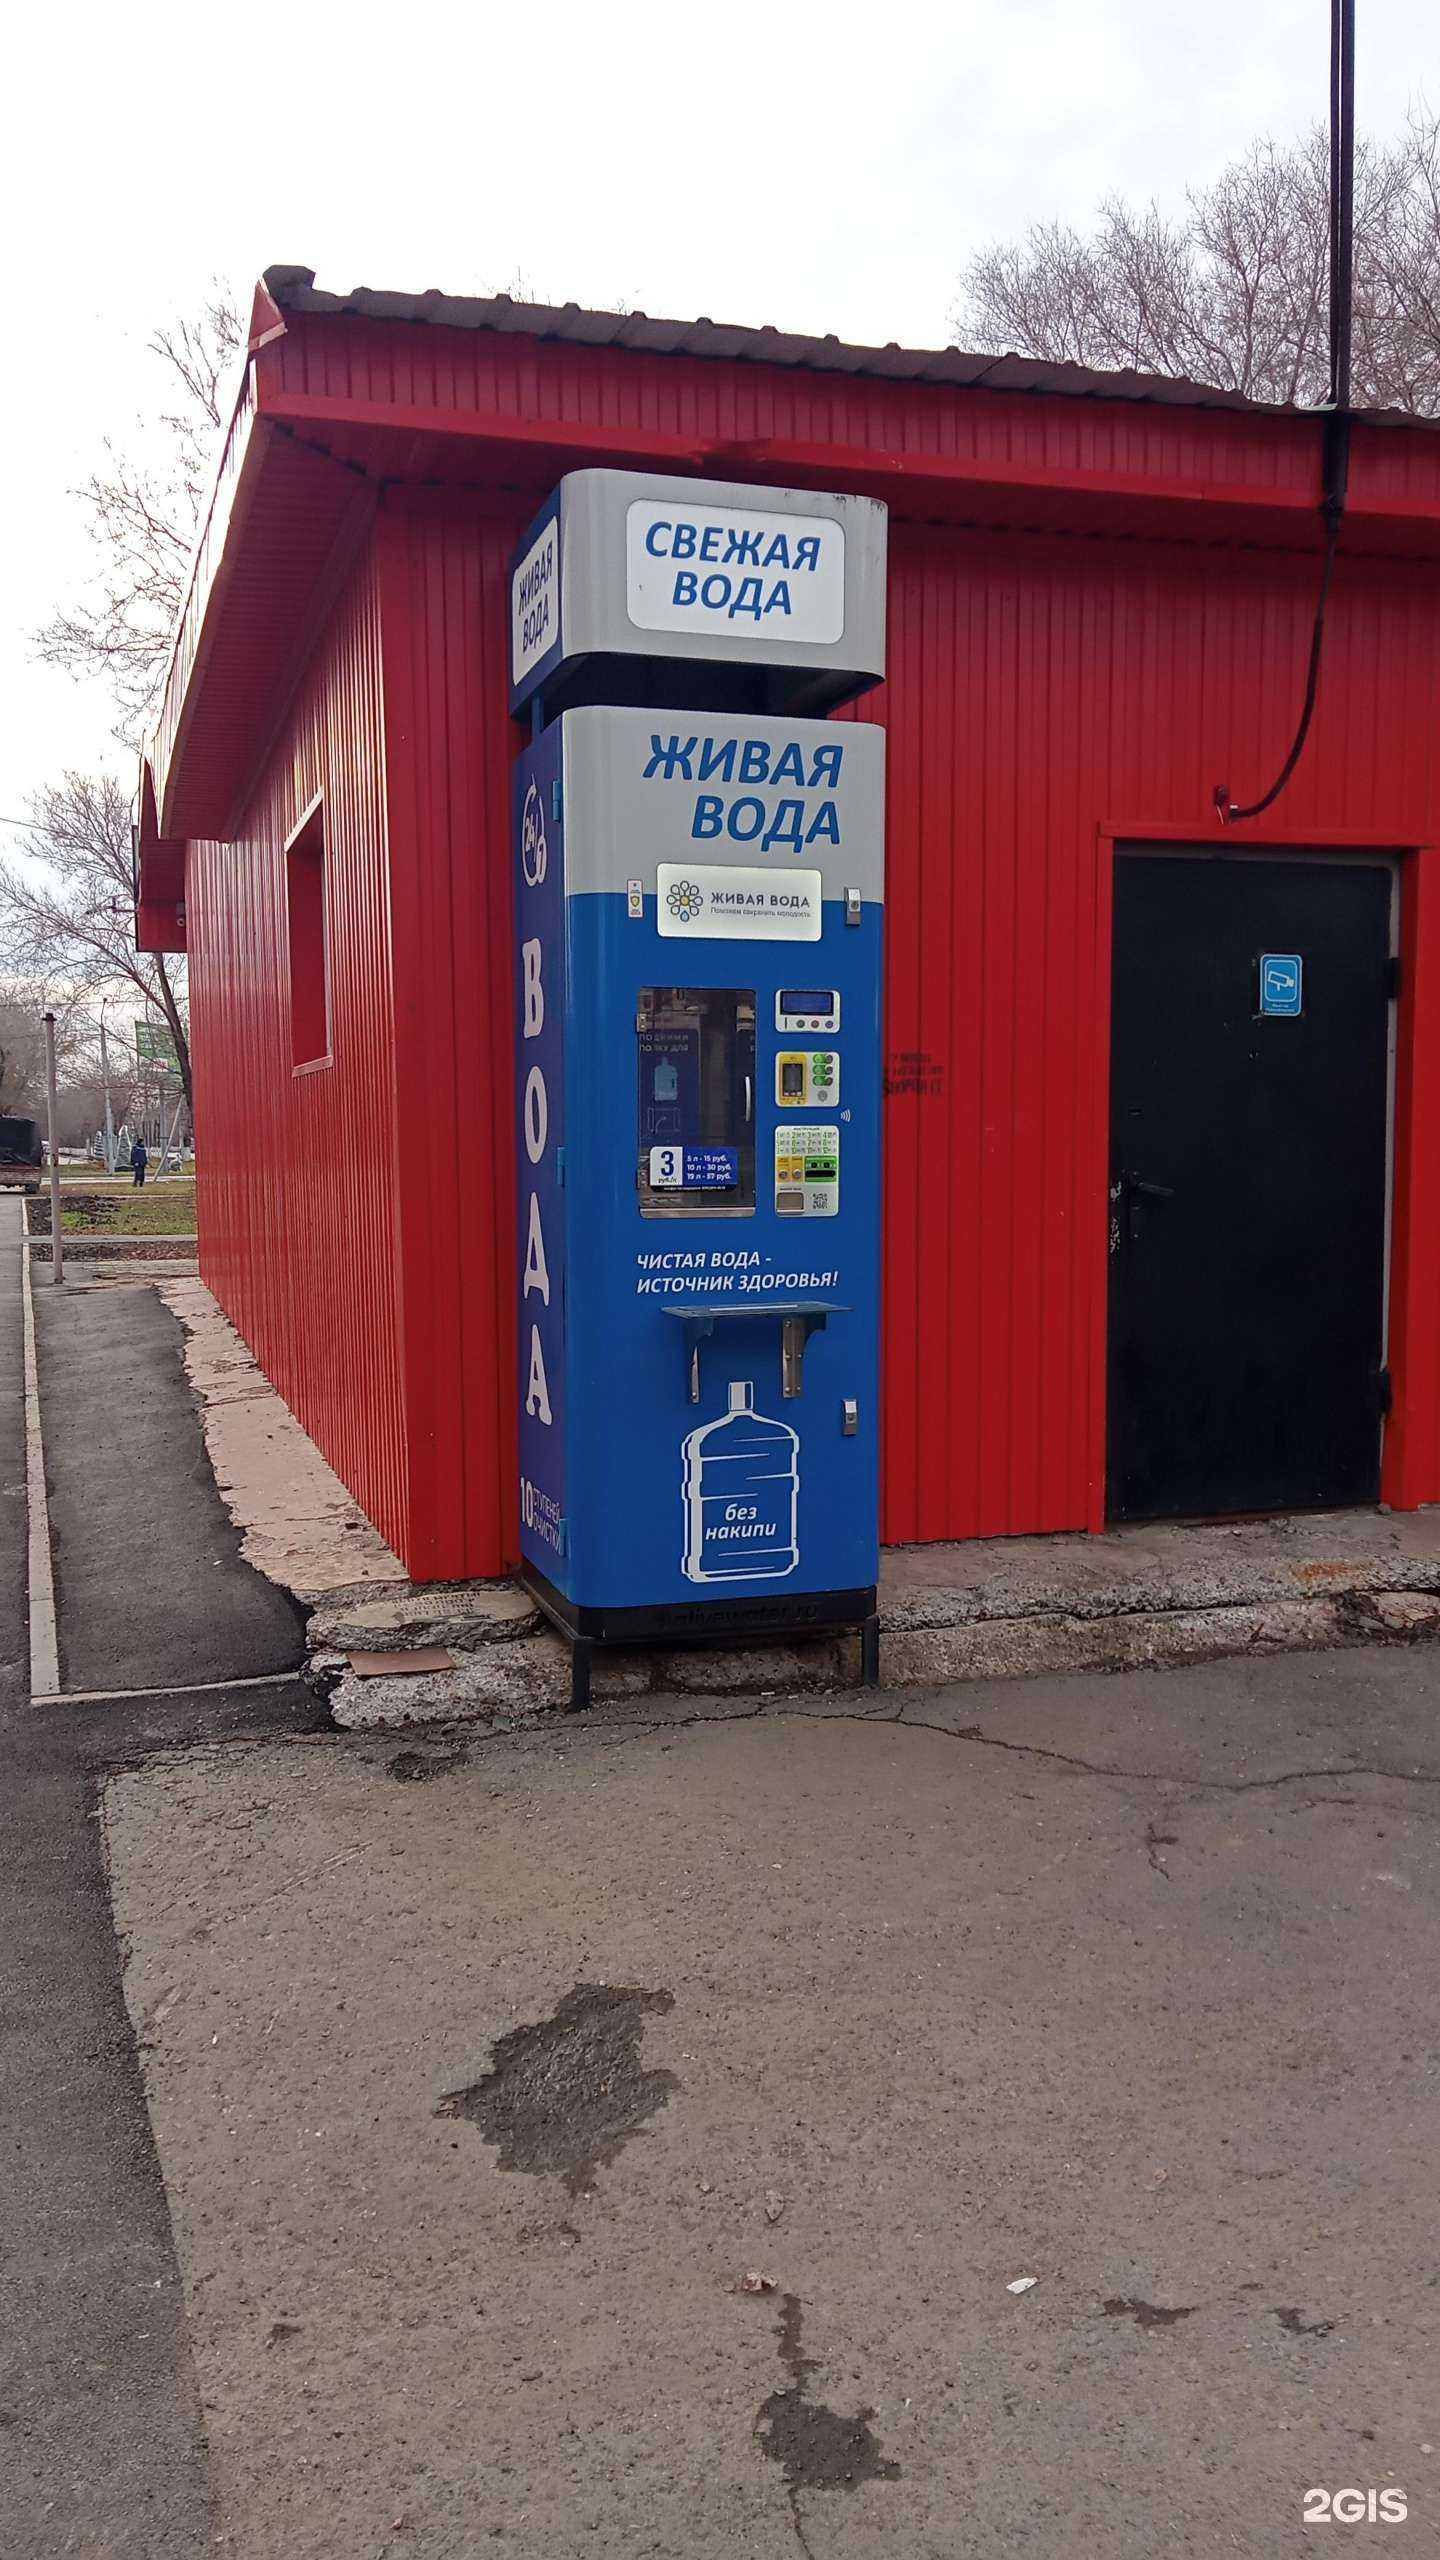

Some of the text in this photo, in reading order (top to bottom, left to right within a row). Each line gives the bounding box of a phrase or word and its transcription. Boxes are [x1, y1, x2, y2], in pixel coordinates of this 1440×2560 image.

[645, 521, 821, 571] СВЕЖАЯ
[518, 541, 552, 616] ЖИВАЯ
[672, 571, 792, 621] ВОДА
[523, 594, 549, 652] ВОДА
[642, 734, 844, 788] ЖИВАЯ
[691, 795, 841, 853] ВОДА
[711, 892, 810, 910] ЖИВАЯ ВОДА
[523, 937, 552, 1426] ВОДА
[661, 1150, 675, 1177] 3
[636, 1271, 838, 1294] ИСТОЧНИК ЗДОРОВЬЯ!
[637, 1253, 706, 1270] ЧИСТАЯ
[710, 1252, 760, 1270] ВОДА
[520, 1476, 534, 1528] 10
[725, 1503, 758, 1521] без
[705, 1522, 777, 1540] накипи
